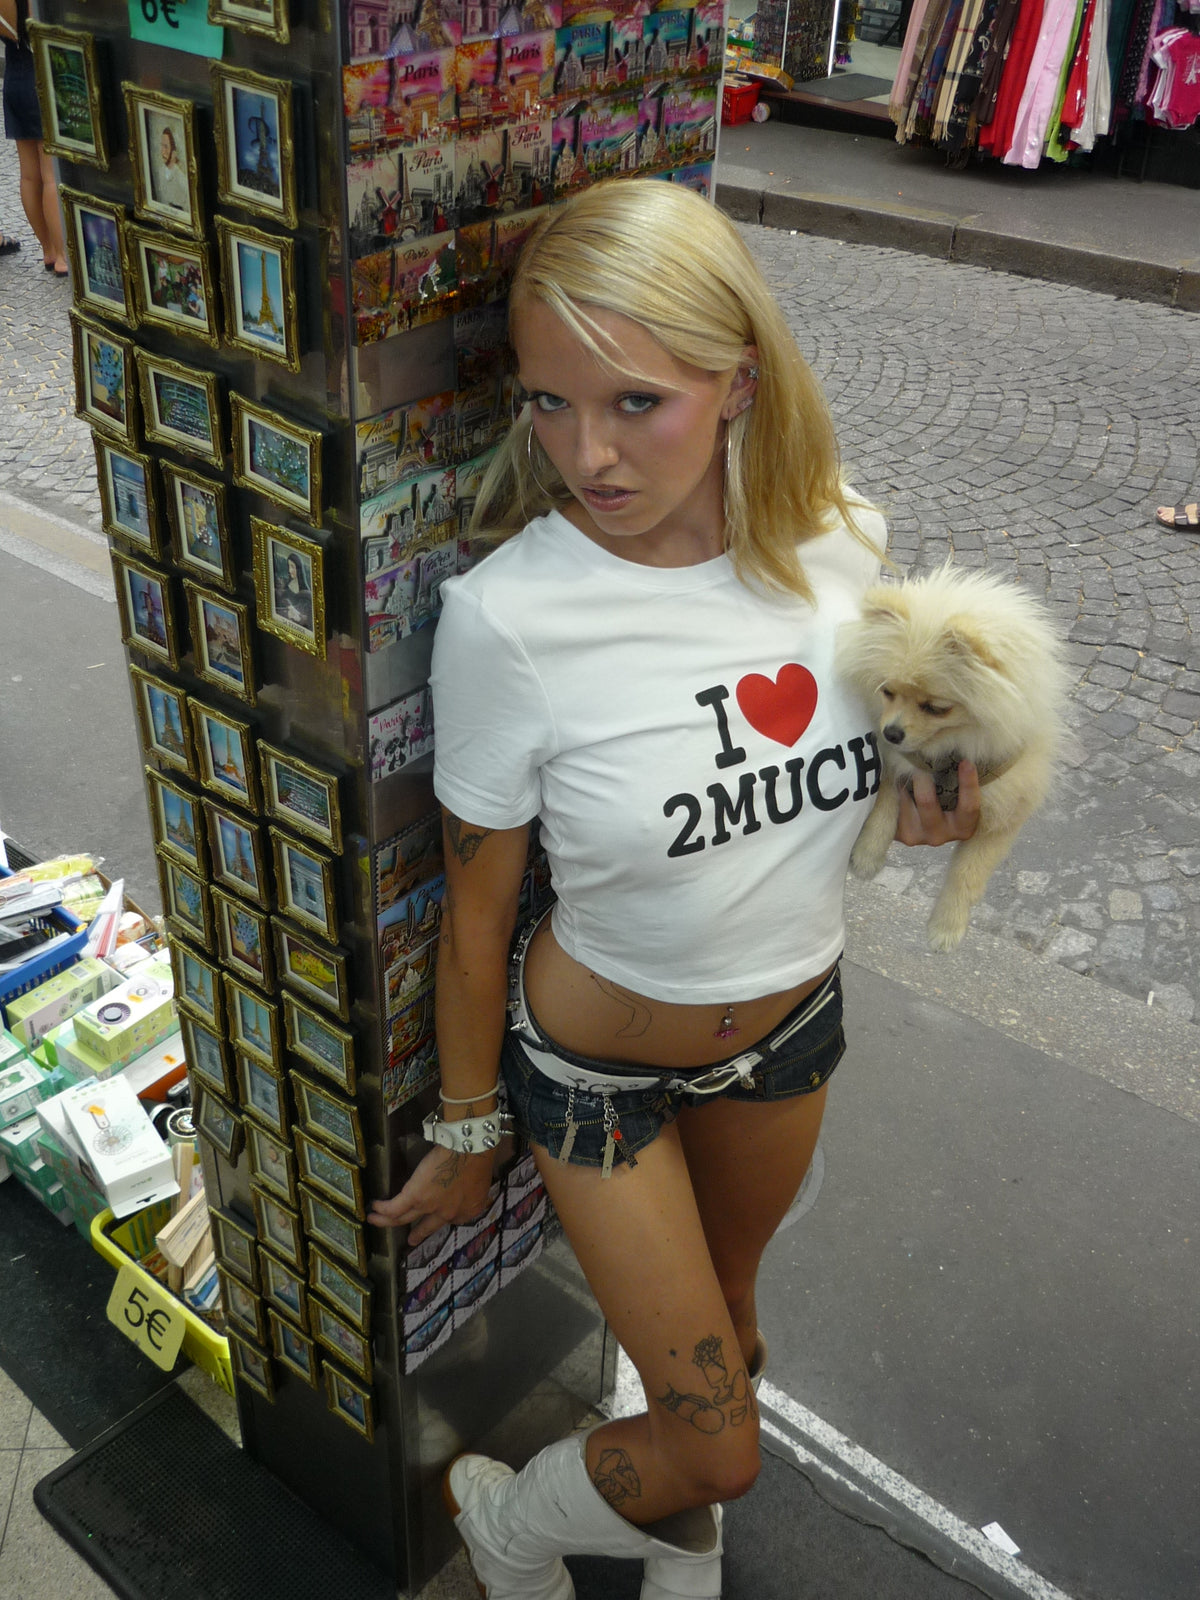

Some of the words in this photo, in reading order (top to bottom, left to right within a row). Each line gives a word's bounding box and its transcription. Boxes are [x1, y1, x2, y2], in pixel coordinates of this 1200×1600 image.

[571, 25, 601, 40] PARIS
[509, 43, 541, 64] Paris
[404, 61, 439, 83] Paris
[511, 126, 542, 147] Paris
[409, 150, 443, 172] Paris
[404, 247, 430, 262] Paris
[379, 713, 404, 733] Paris
[695, 684, 747, 769] I
[662, 731, 883, 858] 2MUCH
[124, 1286, 172, 1352] 5€
